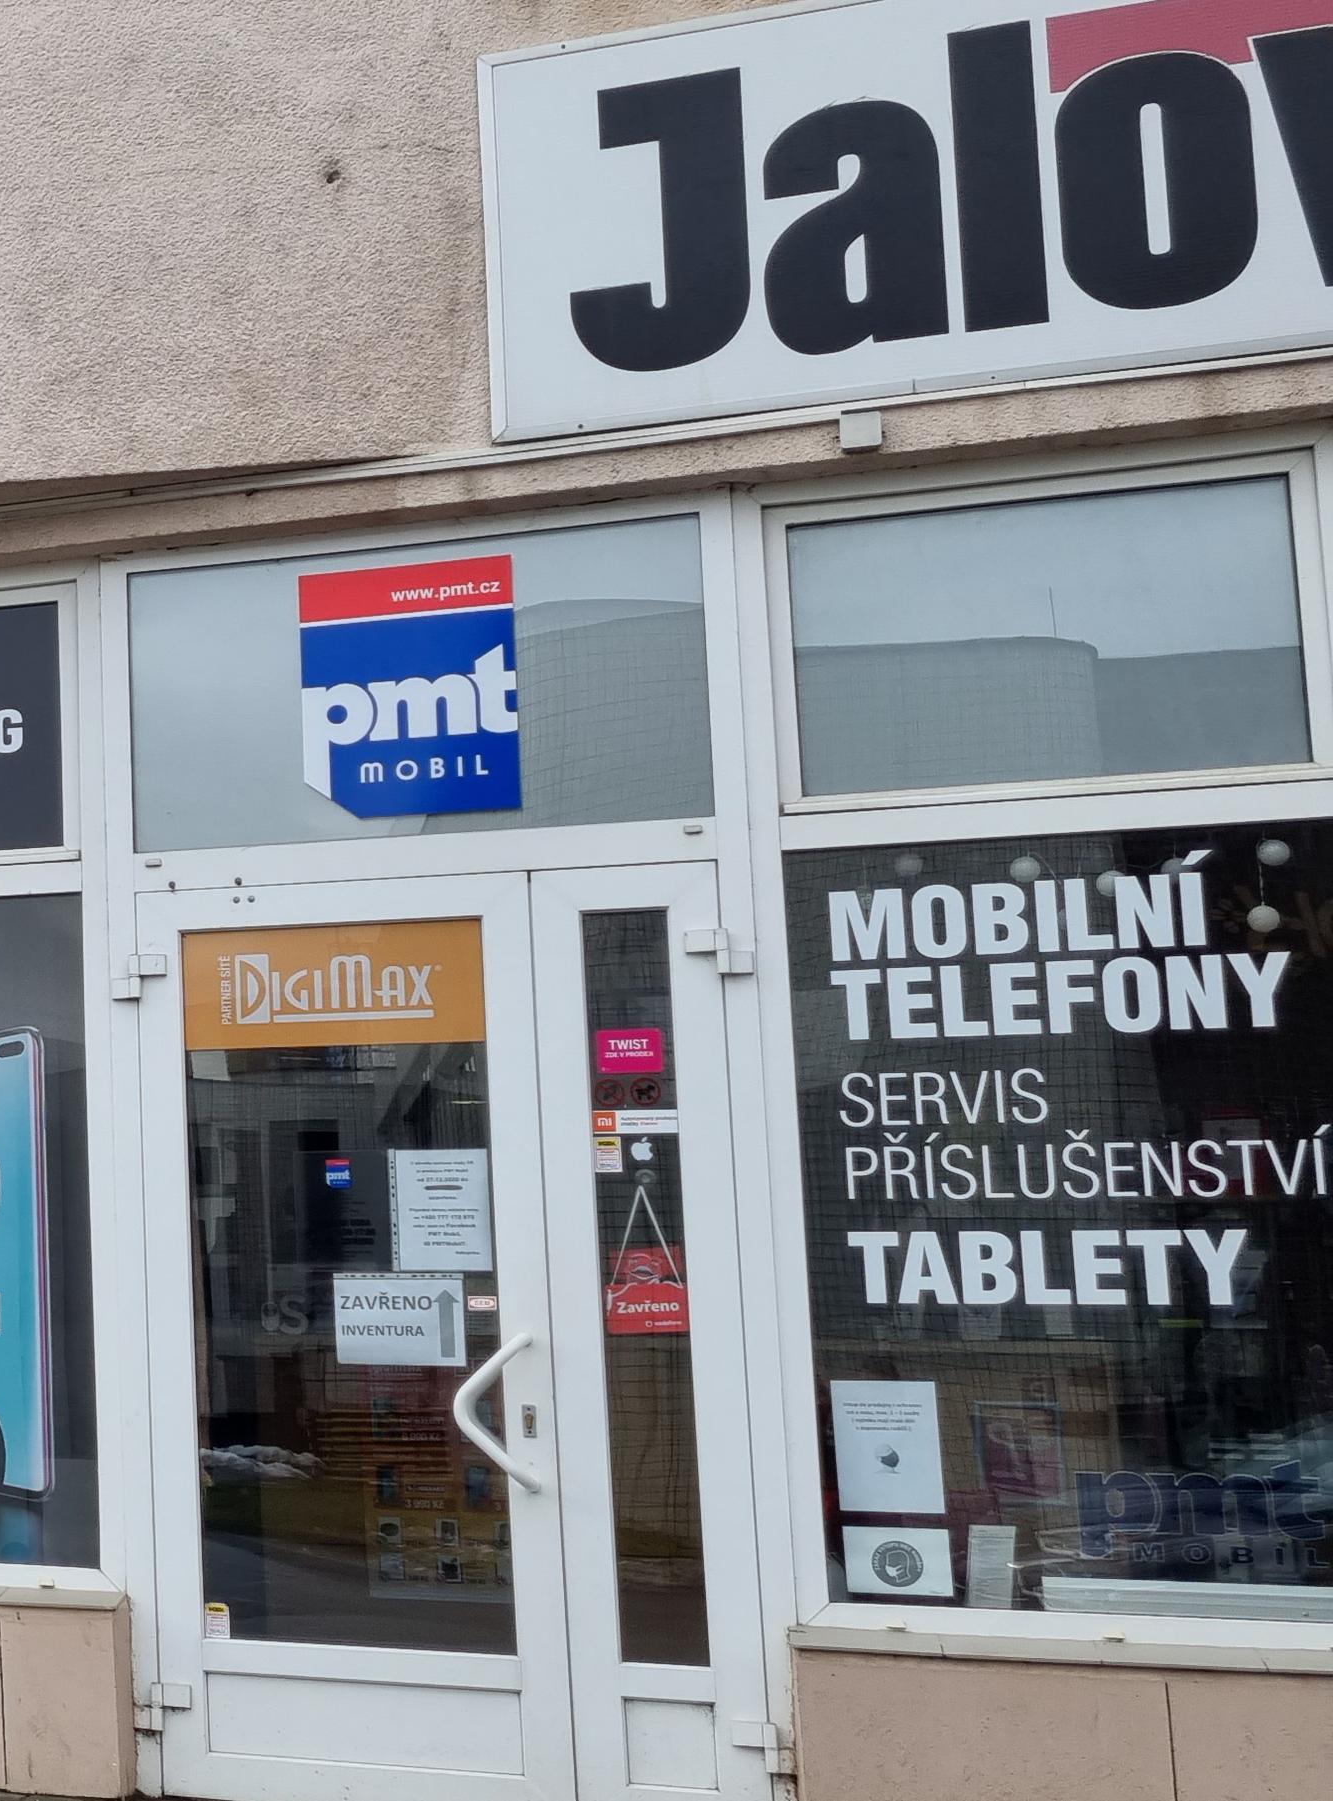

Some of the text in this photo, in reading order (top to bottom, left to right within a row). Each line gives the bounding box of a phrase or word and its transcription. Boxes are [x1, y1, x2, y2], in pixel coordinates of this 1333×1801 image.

[391, 580, 501, 603] www.pmt.cz
[301, 643, 519, 800] pmt
[360, 754, 489, 784] MOBIL
[829, 850, 1212, 961] MOBILNÍ
[831, 951, 1290, 1041] TELEFONY
[608, 1039, 649, 1050] TWIST
[840, 1068, 1049, 1128] SERVIS
[326, 1169, 351, 1185] pmt
[845, 1125, 1331, 1200] PŘÍSLUŠENSTVÍ
[848, 1229, 1247, 1306] TABLETY
[340, 1291, 432, 1311] ZAVŘENO
[616, 1299, 679, 1314] Zavřeno
[341, 1325, 425, 1337] INVENTURA
[1075, 1460, 1326, 1560] pmt
[1133, 1543, 1331, 1568] MOBIL
